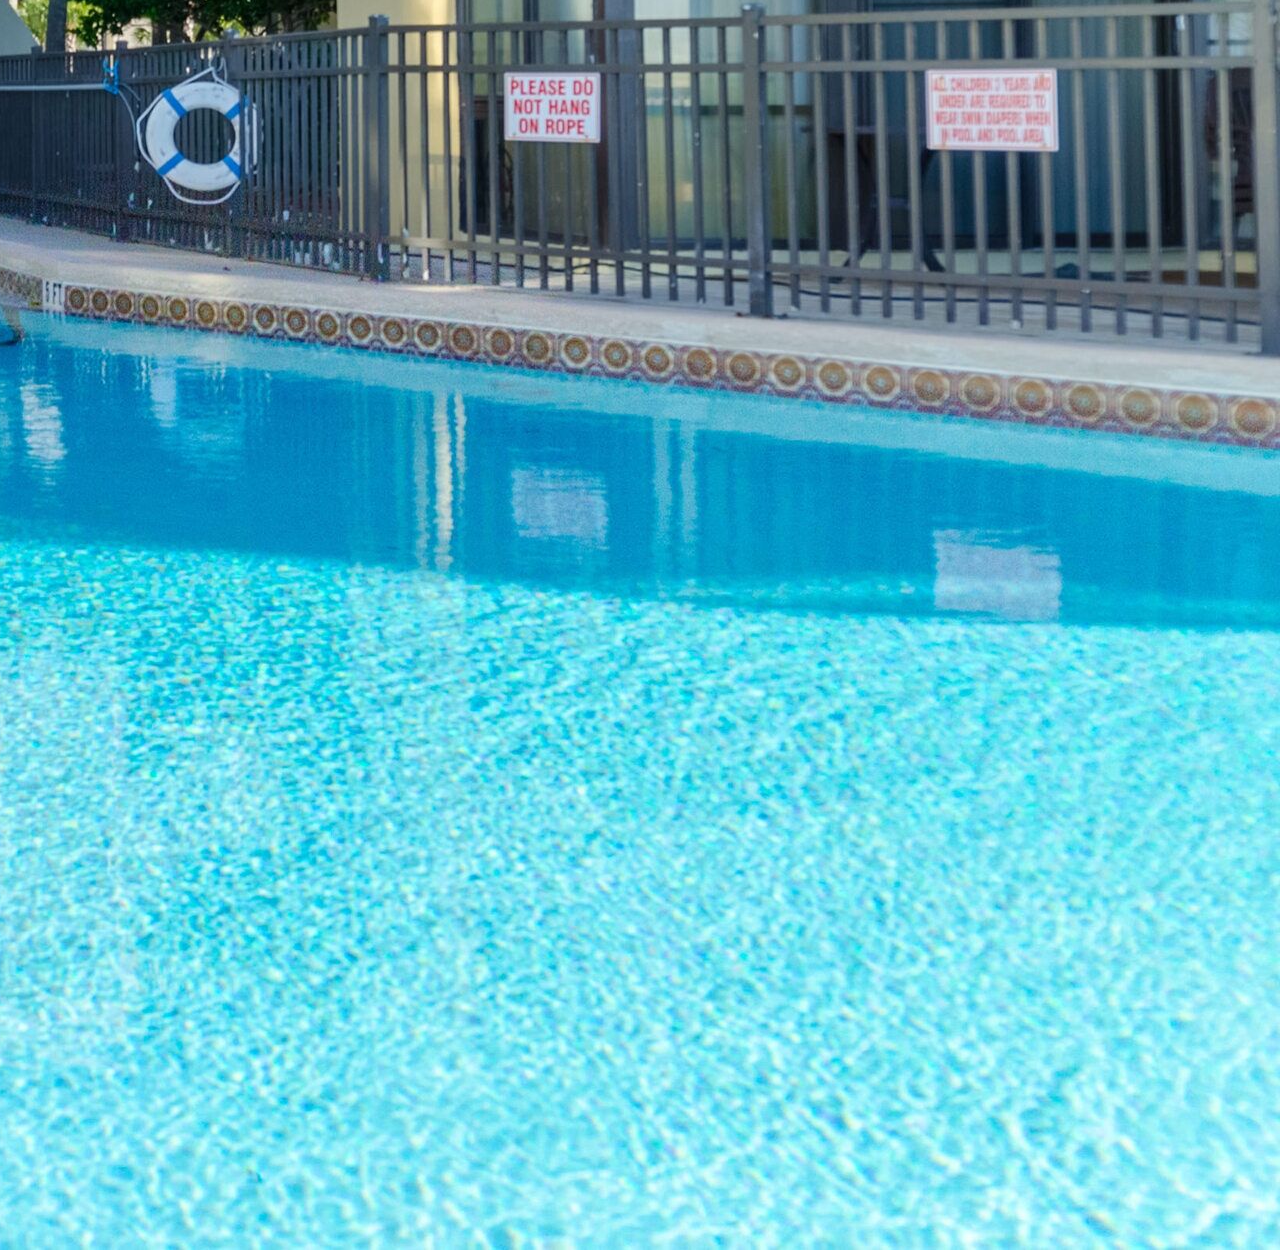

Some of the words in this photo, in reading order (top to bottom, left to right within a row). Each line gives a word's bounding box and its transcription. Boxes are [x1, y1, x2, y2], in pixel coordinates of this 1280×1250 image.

[510, 80, 566, 96] PLEASE
[573, 80, 593, 96] DO
[950, 77, 992, 91] CHILDREN
[1002, 77, 1031, 91] YEARS
[513, 99, 543, 115] NOT
[549, 99, 590, 115] HANG
[970, 95, 987, 108] ARE
[989, 95, 1030, 108] REQUIRED
[1034, 95, 1046, 108] TO
[934, 111, 957, 125] WEAR
[519, 118, 538, 134] ON
[545, 118, 585, 134] ROPE
